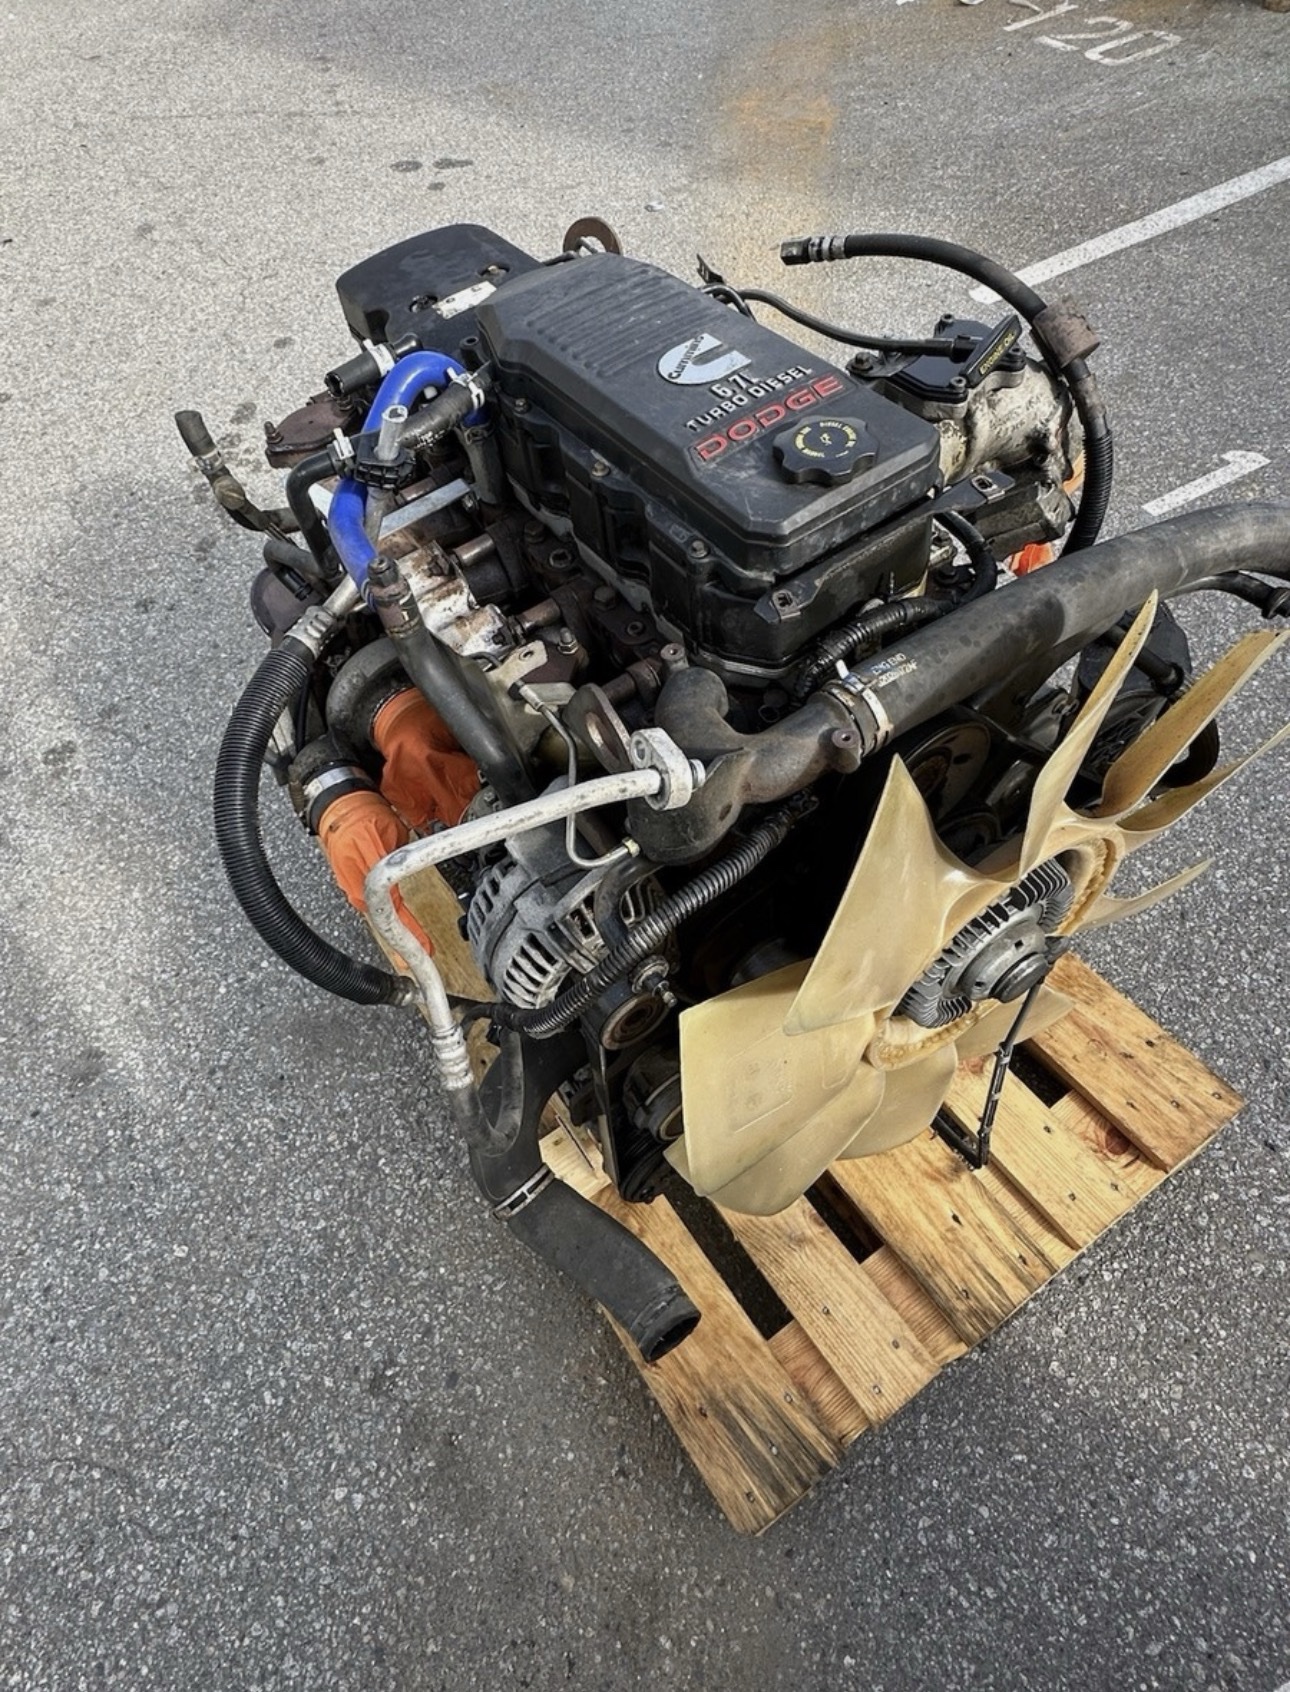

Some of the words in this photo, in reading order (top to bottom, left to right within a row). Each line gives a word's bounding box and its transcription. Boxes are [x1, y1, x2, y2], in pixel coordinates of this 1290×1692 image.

[686, 394, 749, 432] TURBO
[749, 365, 813, 398] DIESEL
[695, 375, 844, 460] DODGE
[711, 370, 760, 399] 6.7L
